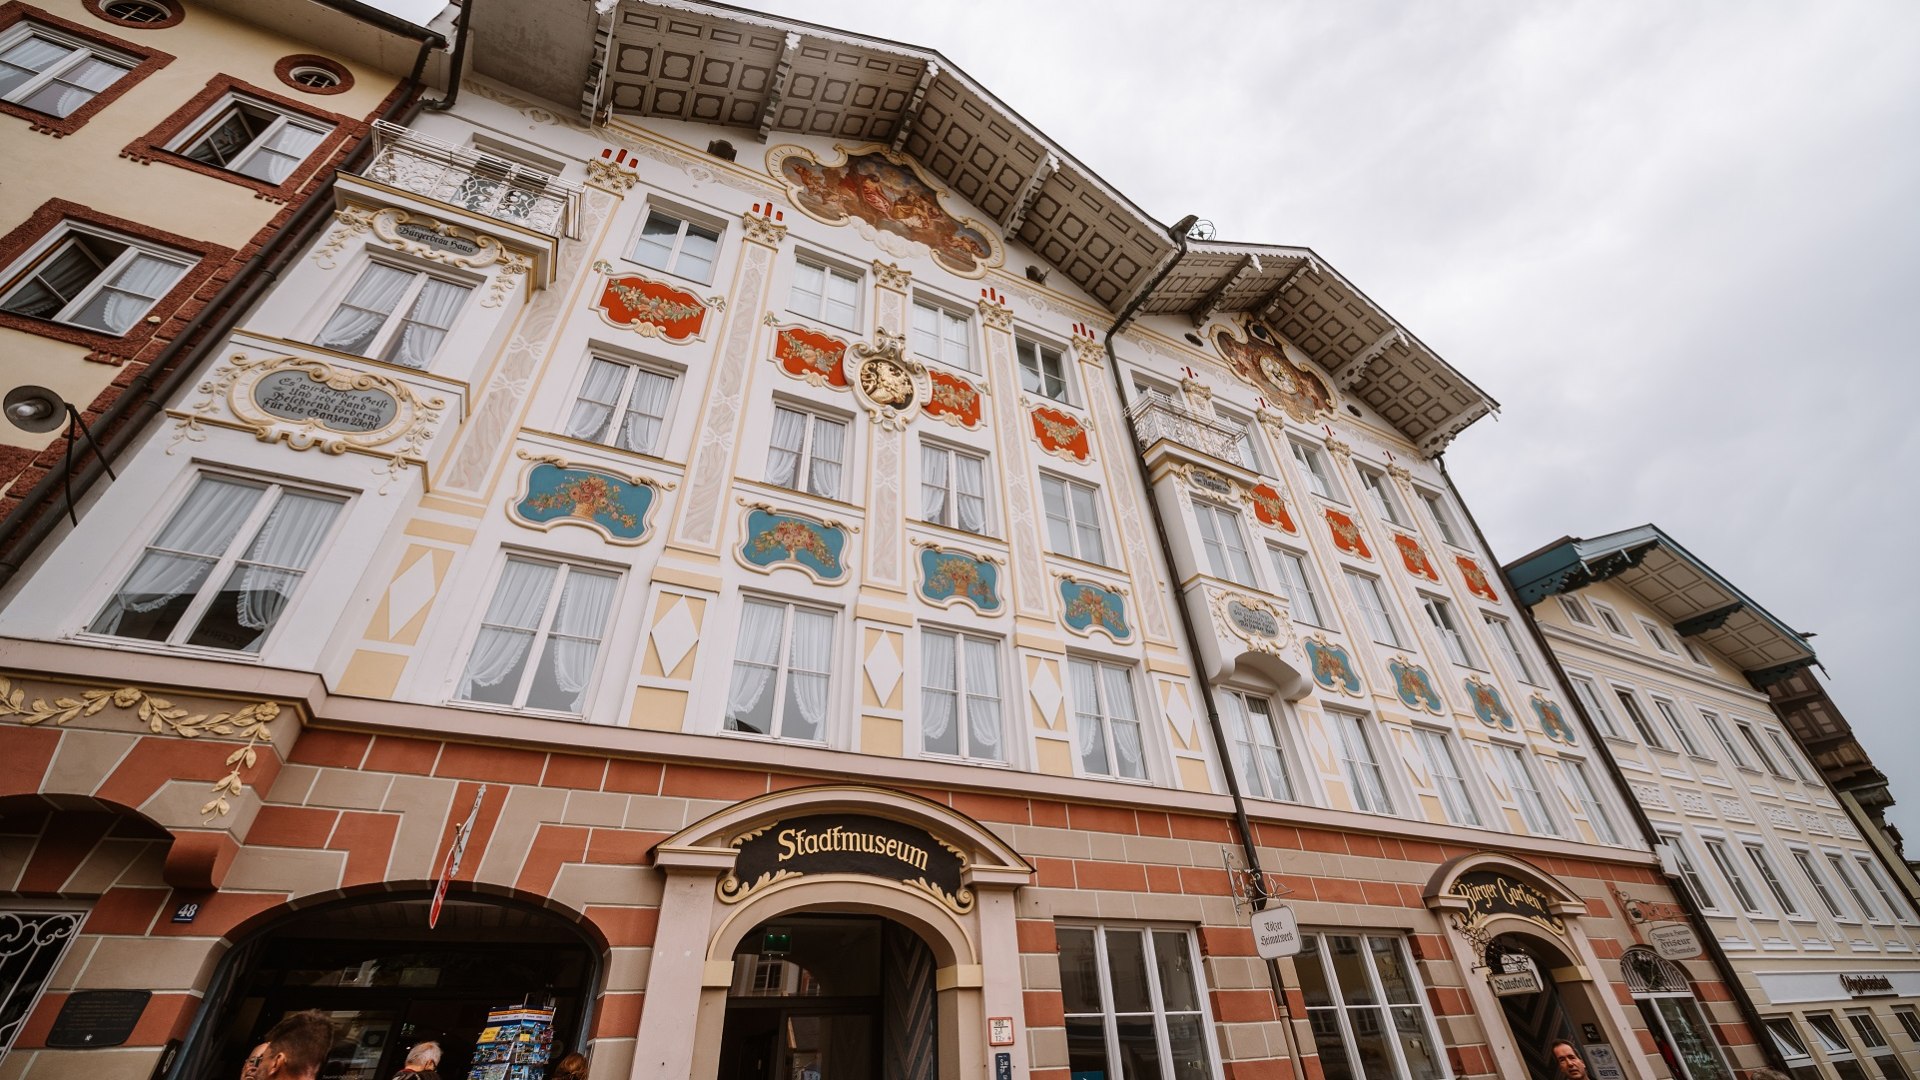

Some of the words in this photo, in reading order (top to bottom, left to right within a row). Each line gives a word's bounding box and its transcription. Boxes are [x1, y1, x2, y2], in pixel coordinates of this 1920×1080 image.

[450, 240, 473, 253] Haus
[289, 388, 312, 398] Und
[315, 393, 336, 403] jede
[339, 398, 366, 410] Hand
[299, 383, 331, 395] wirke
[332, 390, 358, 401] jeder
[284, 403, 304, 414] des
[307, 408, 349, 424] Ganzen
[778, 825, 929, 870] Stadtmuseum
[1458, 883, 1497, 917] Bürger
[1497, 877, 1545, 912] Garten
[178, 903, 198, 917] 48
[1264, 921, 1283, 932] Tölzer
[1261, 932, 1293, 946] Heimatwerk
[1657, 938, 1691, 950] Friseur
[1494, 976, 1534, 992] Ratskeller
